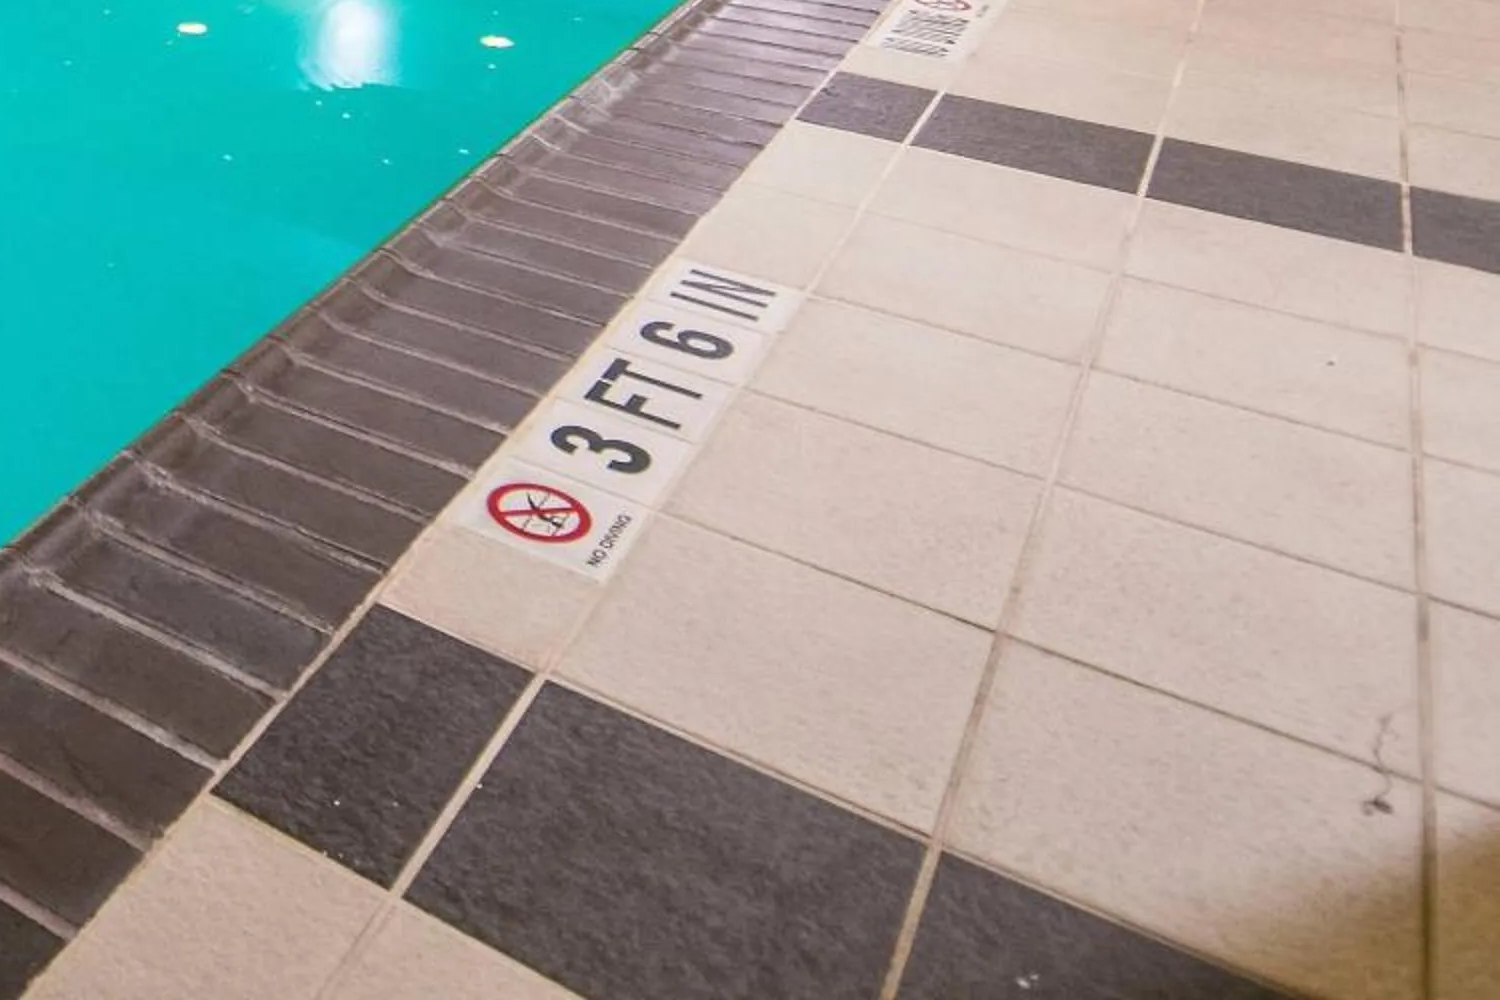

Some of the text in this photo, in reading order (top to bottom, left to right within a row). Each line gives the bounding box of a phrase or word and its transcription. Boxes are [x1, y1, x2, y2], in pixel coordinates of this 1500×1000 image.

[550, 269, 777, 475] 3 FT 6 IN
[586, 514, 633, 567] NO DIVING
